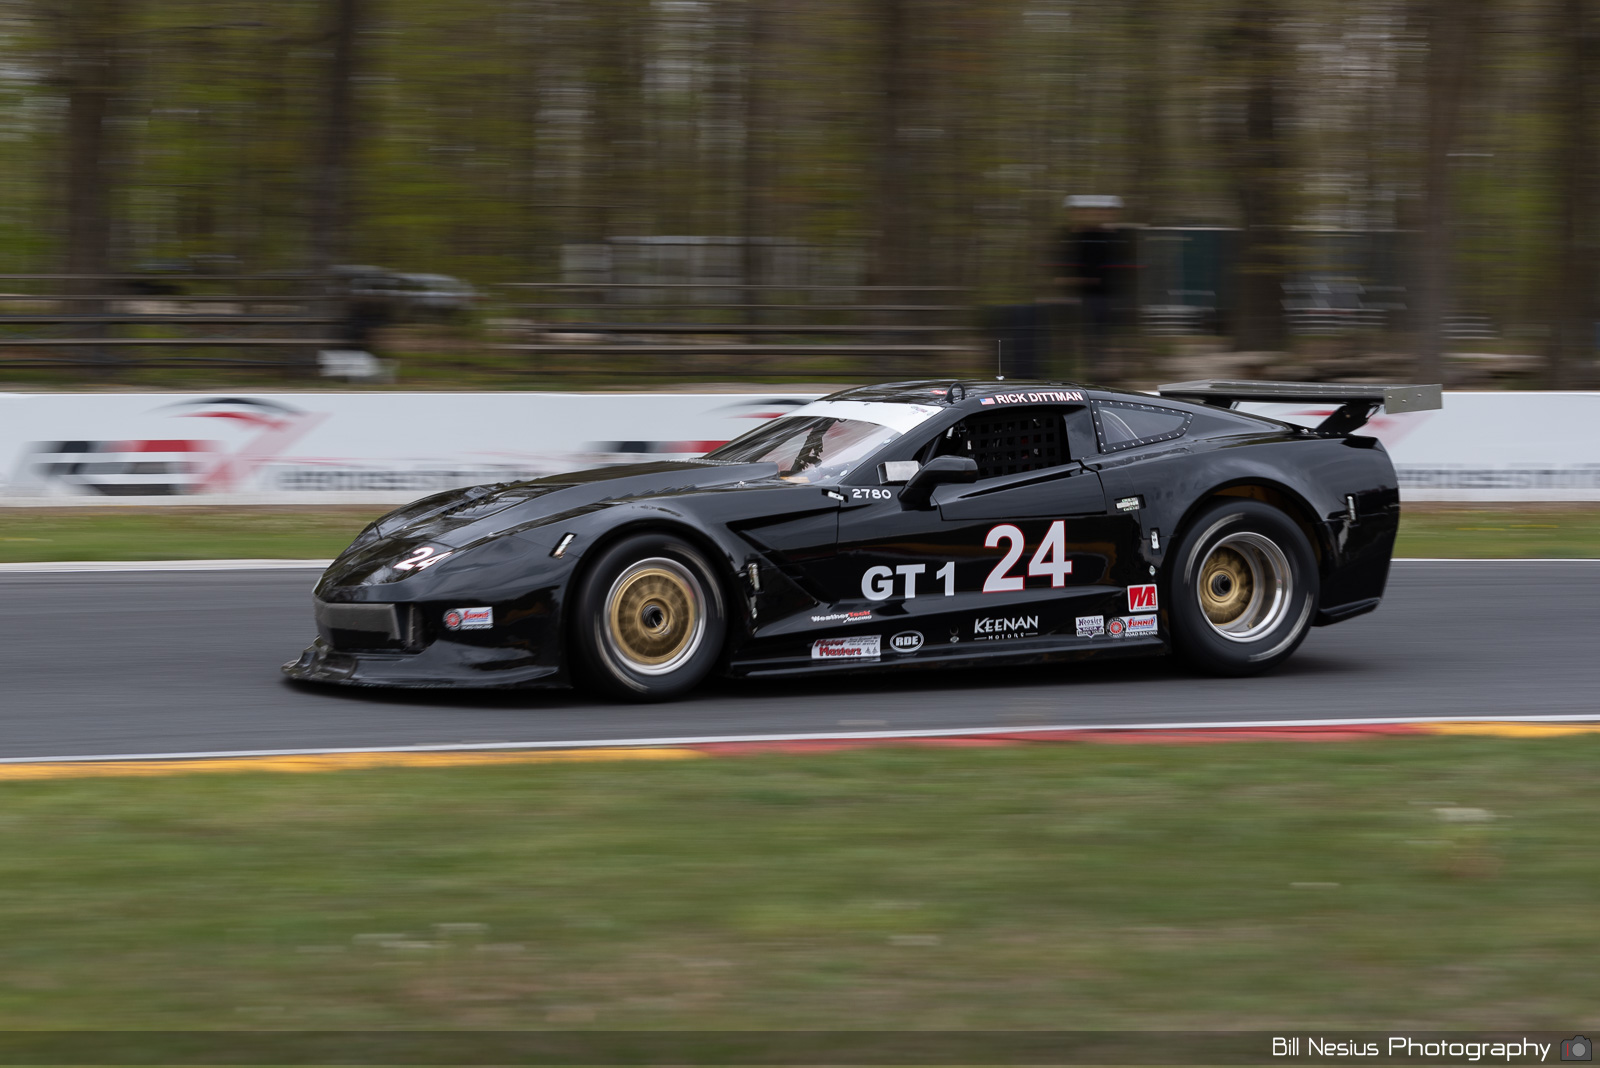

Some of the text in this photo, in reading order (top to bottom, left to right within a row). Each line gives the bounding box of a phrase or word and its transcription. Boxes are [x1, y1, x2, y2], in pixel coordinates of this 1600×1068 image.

[994, 391, 1084, 405] RICK DITTMAN
[851, 488, 892, 499] 2780
[392, 546, 455, 572] 24
[982, 519, 1073, 594] 24
[861, 561, 956, 601] GT 1
[974, 615, 1039, 634] KEENAN
[895, 635, 919, 647] RDE
[988, 632, 1025, 640] MOTORS
[818, 646, 863, 657] Masters
